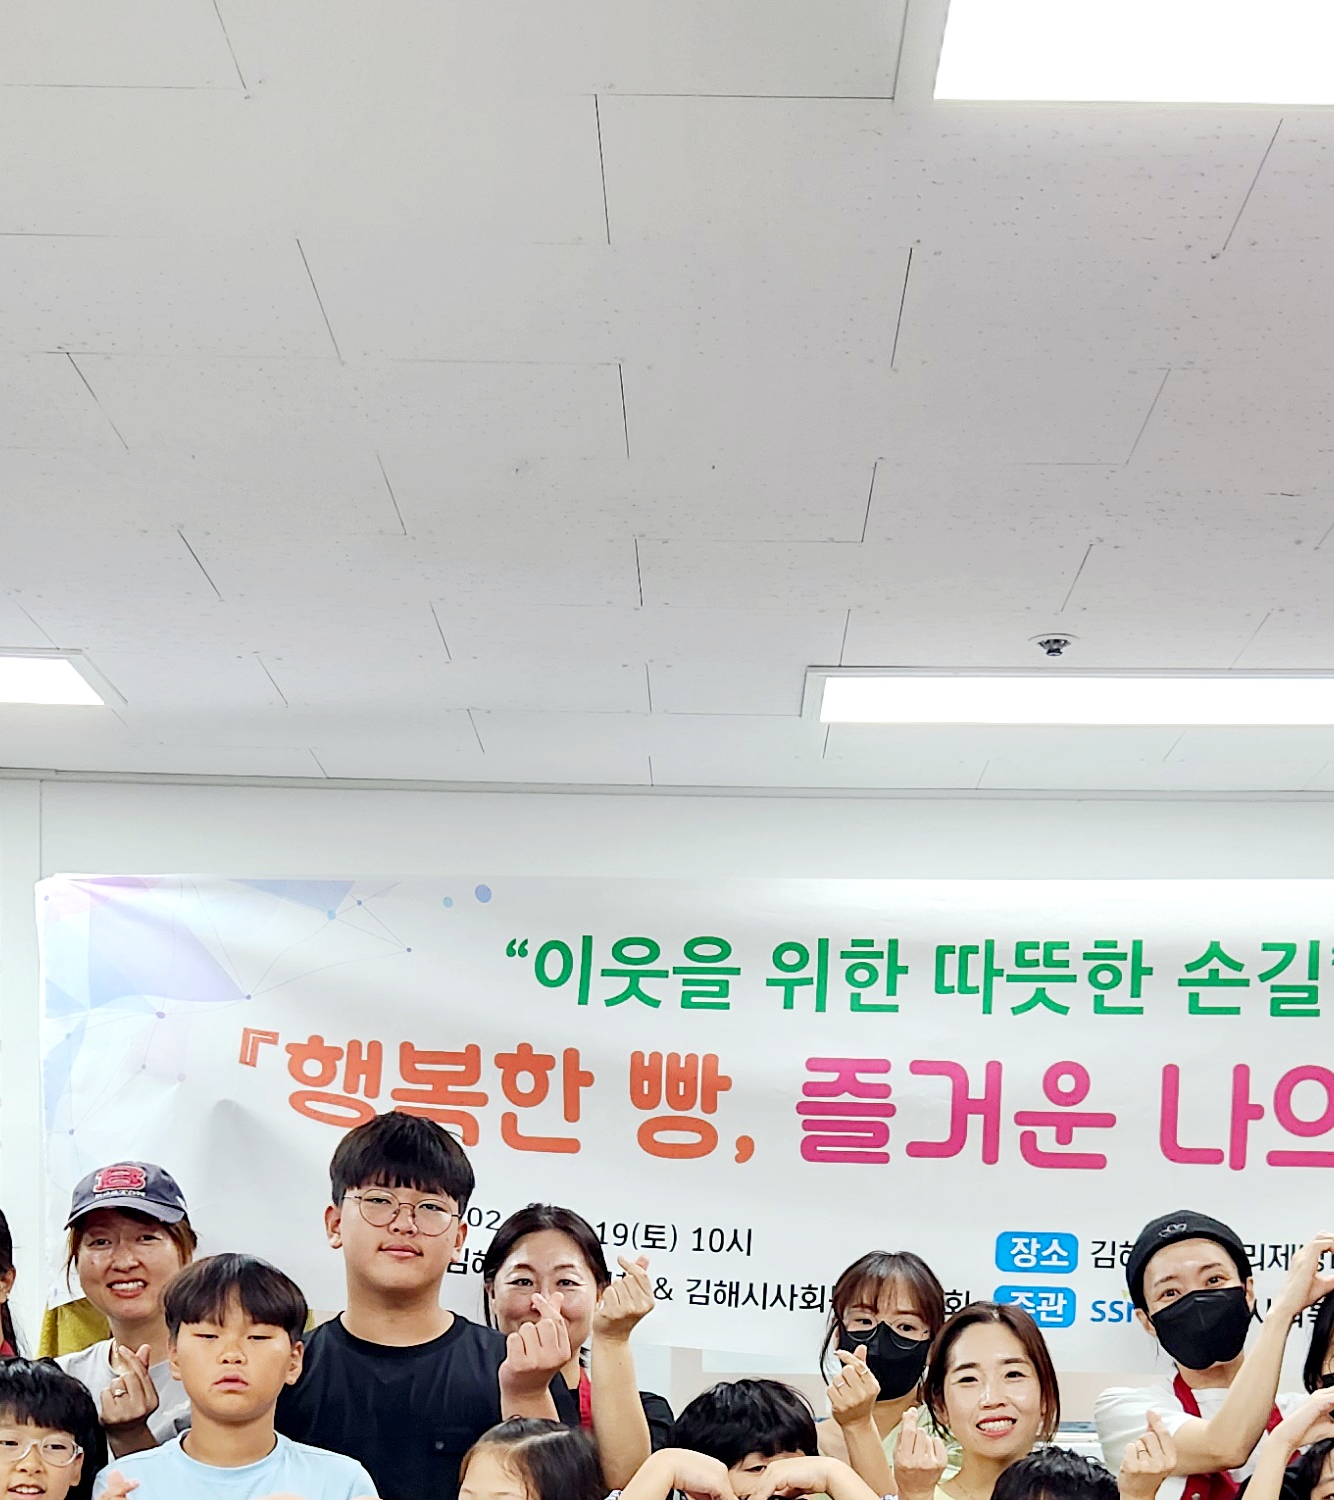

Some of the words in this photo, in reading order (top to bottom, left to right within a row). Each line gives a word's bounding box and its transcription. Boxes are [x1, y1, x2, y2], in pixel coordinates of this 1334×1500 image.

[505, 935, 742, 1012] “이웃을
[765, 937, 910, 1014] 위한
[933, 938, 1154, 1017] 따뜻한
[629, 1049, 756, 1165] 빵,
[795, 1056, 1117, 1171] 즐거운
[692, 1226, 752, 1257] 10시
[1010, 1236, 1070, 1268] 장소
[653, 1276, 674, 1301] &
